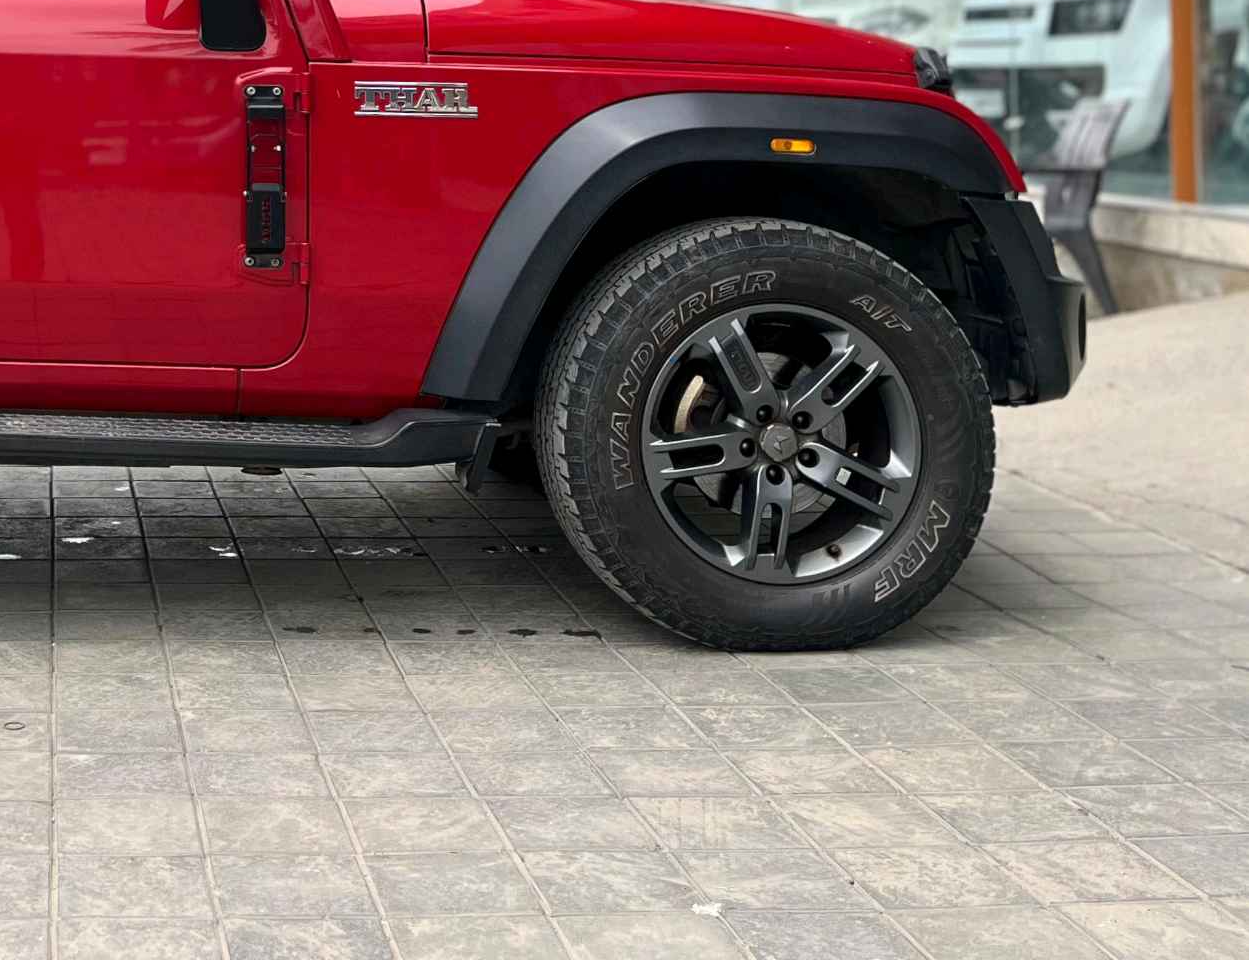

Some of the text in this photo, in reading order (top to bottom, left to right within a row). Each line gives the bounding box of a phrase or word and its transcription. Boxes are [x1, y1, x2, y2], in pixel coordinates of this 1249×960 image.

[354, 84, 478, 115] THAR
[609, 271, 776, 490] WANDERER
[874, 500, 950, 602] MRF
